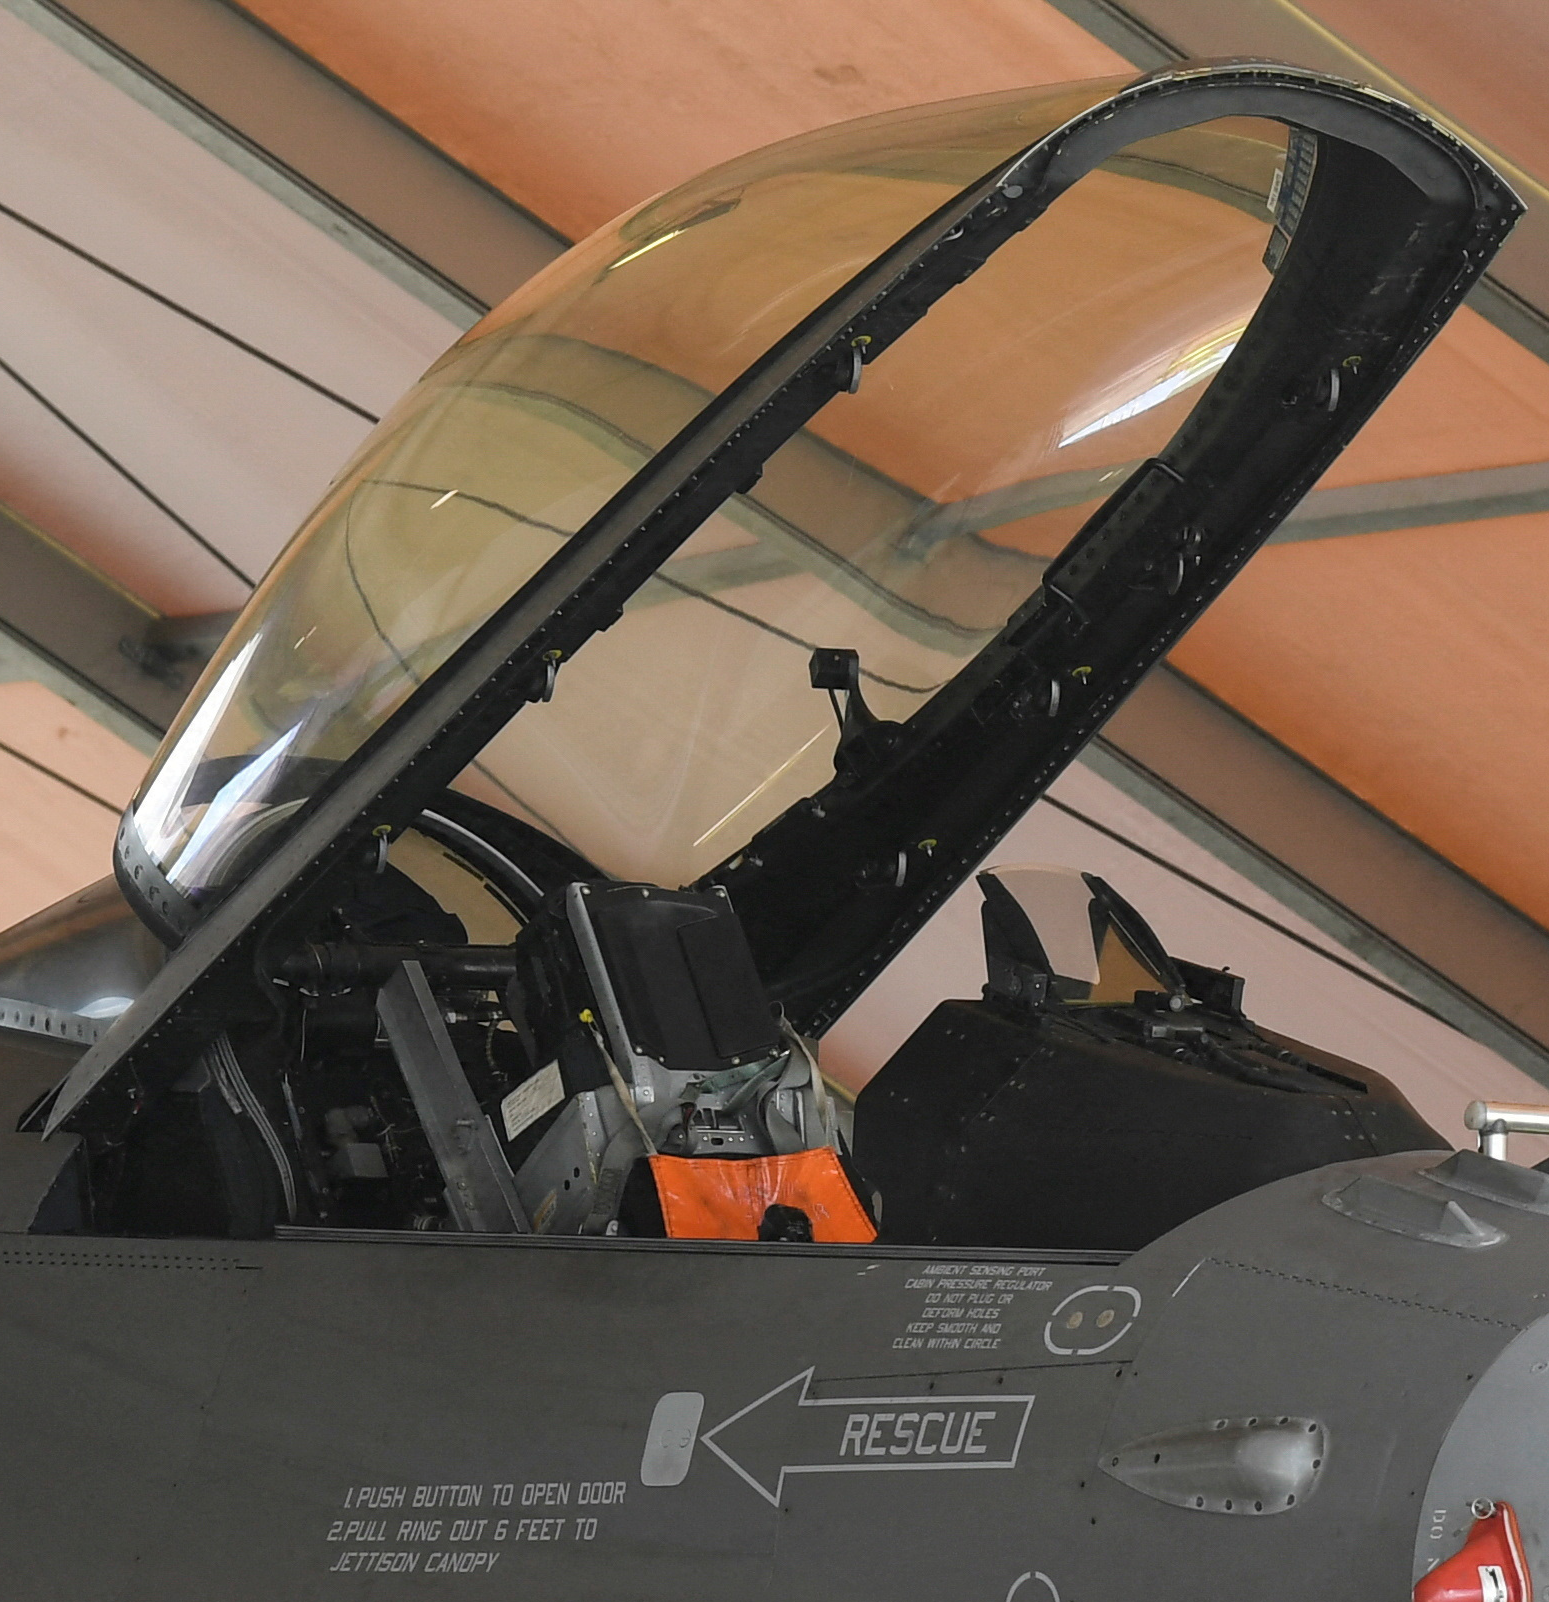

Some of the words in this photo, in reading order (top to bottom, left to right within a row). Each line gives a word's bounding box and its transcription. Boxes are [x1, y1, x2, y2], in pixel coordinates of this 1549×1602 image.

[922, 1264, 968, 1275] AMBIENT
[969, 1265, 1015, 1276] SENSING
[1016, 1266, 1046, 1277] PORT
[904, 1278, 936, 1289] CABIN
[936, 1278, 992, 1290] PRESSURE
[993, 1279, 1053, 1291] REGULATOR
[925, 1292, 942, 1304] DO
[943, 1293, 965, 1304] NOT
[966, 1293, 996, 1304] PLUG
[997, 1293, 1014, 1305] OR
[921, 1307, 965, 1319] DEFORM
[966, 1307, 1001, 1319] HOLES
[905, 1322, 935, 1334] KEEP
[936, 1322, 979, 1334] SMOOTH
[981, 1323, 1002, 1334] AND
[892, 1337, 925, 1349] CLEAN
[926, 1337, 962, 1349] WITHIN
[963, 1338, 1002, 1349] CIRCLE
[839, 1411, 997, 1456] RESCUE
[412, 1484, 483, 1508] BUTTON
[492, 1483, 514, 1506] TO
[521, 1482, 571, 1506] OPEN
[577, 1481, 627, 1505] DOOR
[492, 1483, 514, 1506] TO
[396, 1520, 441, 1542] RING
[449, 1519, 489, 1541] OUT
[493, 1519, 508, 1541] 6
[515, 1518, 566, 1541] FEET
[329, 1552, 421, 1573] JETTISON
[424, 1552, 500, 1573] CANOPY
